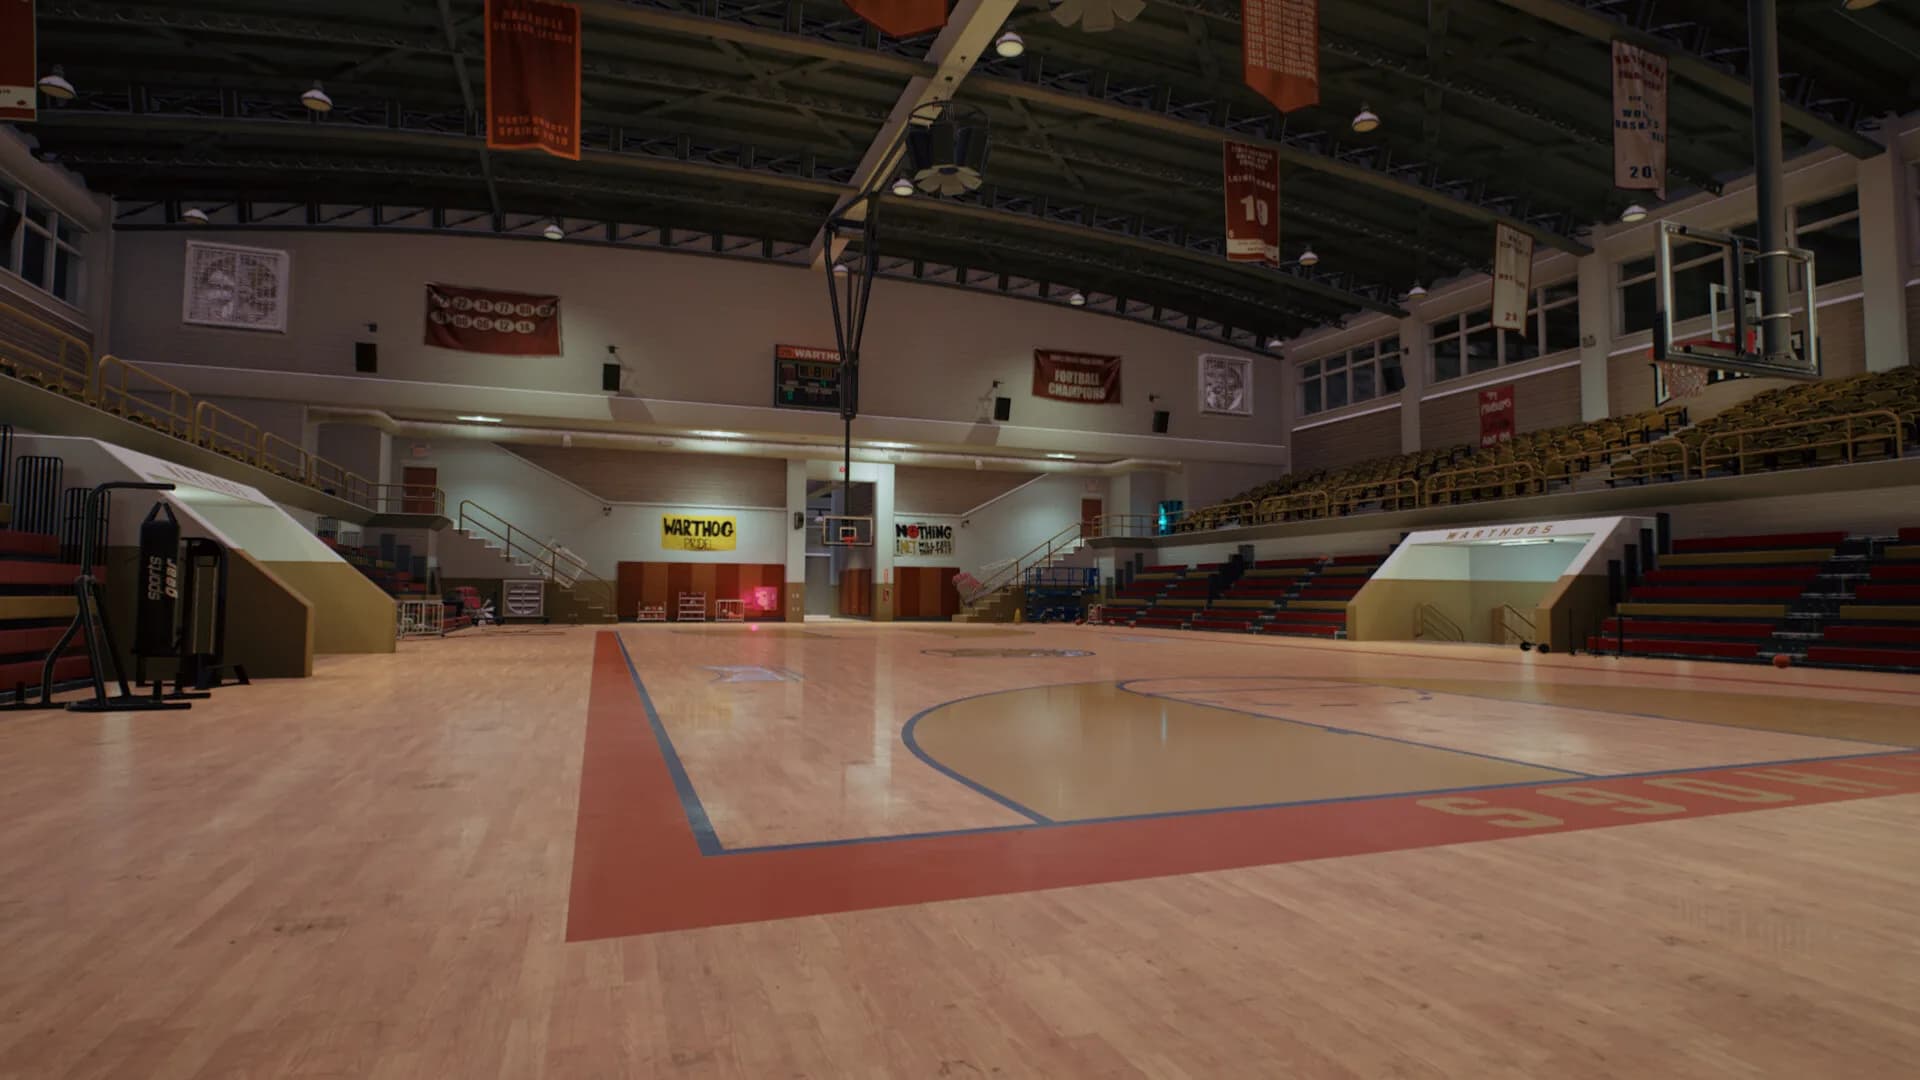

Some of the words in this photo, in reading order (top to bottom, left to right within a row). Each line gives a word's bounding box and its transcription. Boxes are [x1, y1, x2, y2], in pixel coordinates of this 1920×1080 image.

[1240, 194, 1269, 227] 10
[1054, 368, 1100, 386] FOOTBALL
[1048, 382, 1107, 400] CHAMPIONS
[664, 518, 734, 537] WARTHOG
[895, 523, 953, 540] NOTHING
[1446, 525, 1554, 541] WARTHOGS
[147, 553, 162, 601] sports
[164, 557, 178, 599] gear
